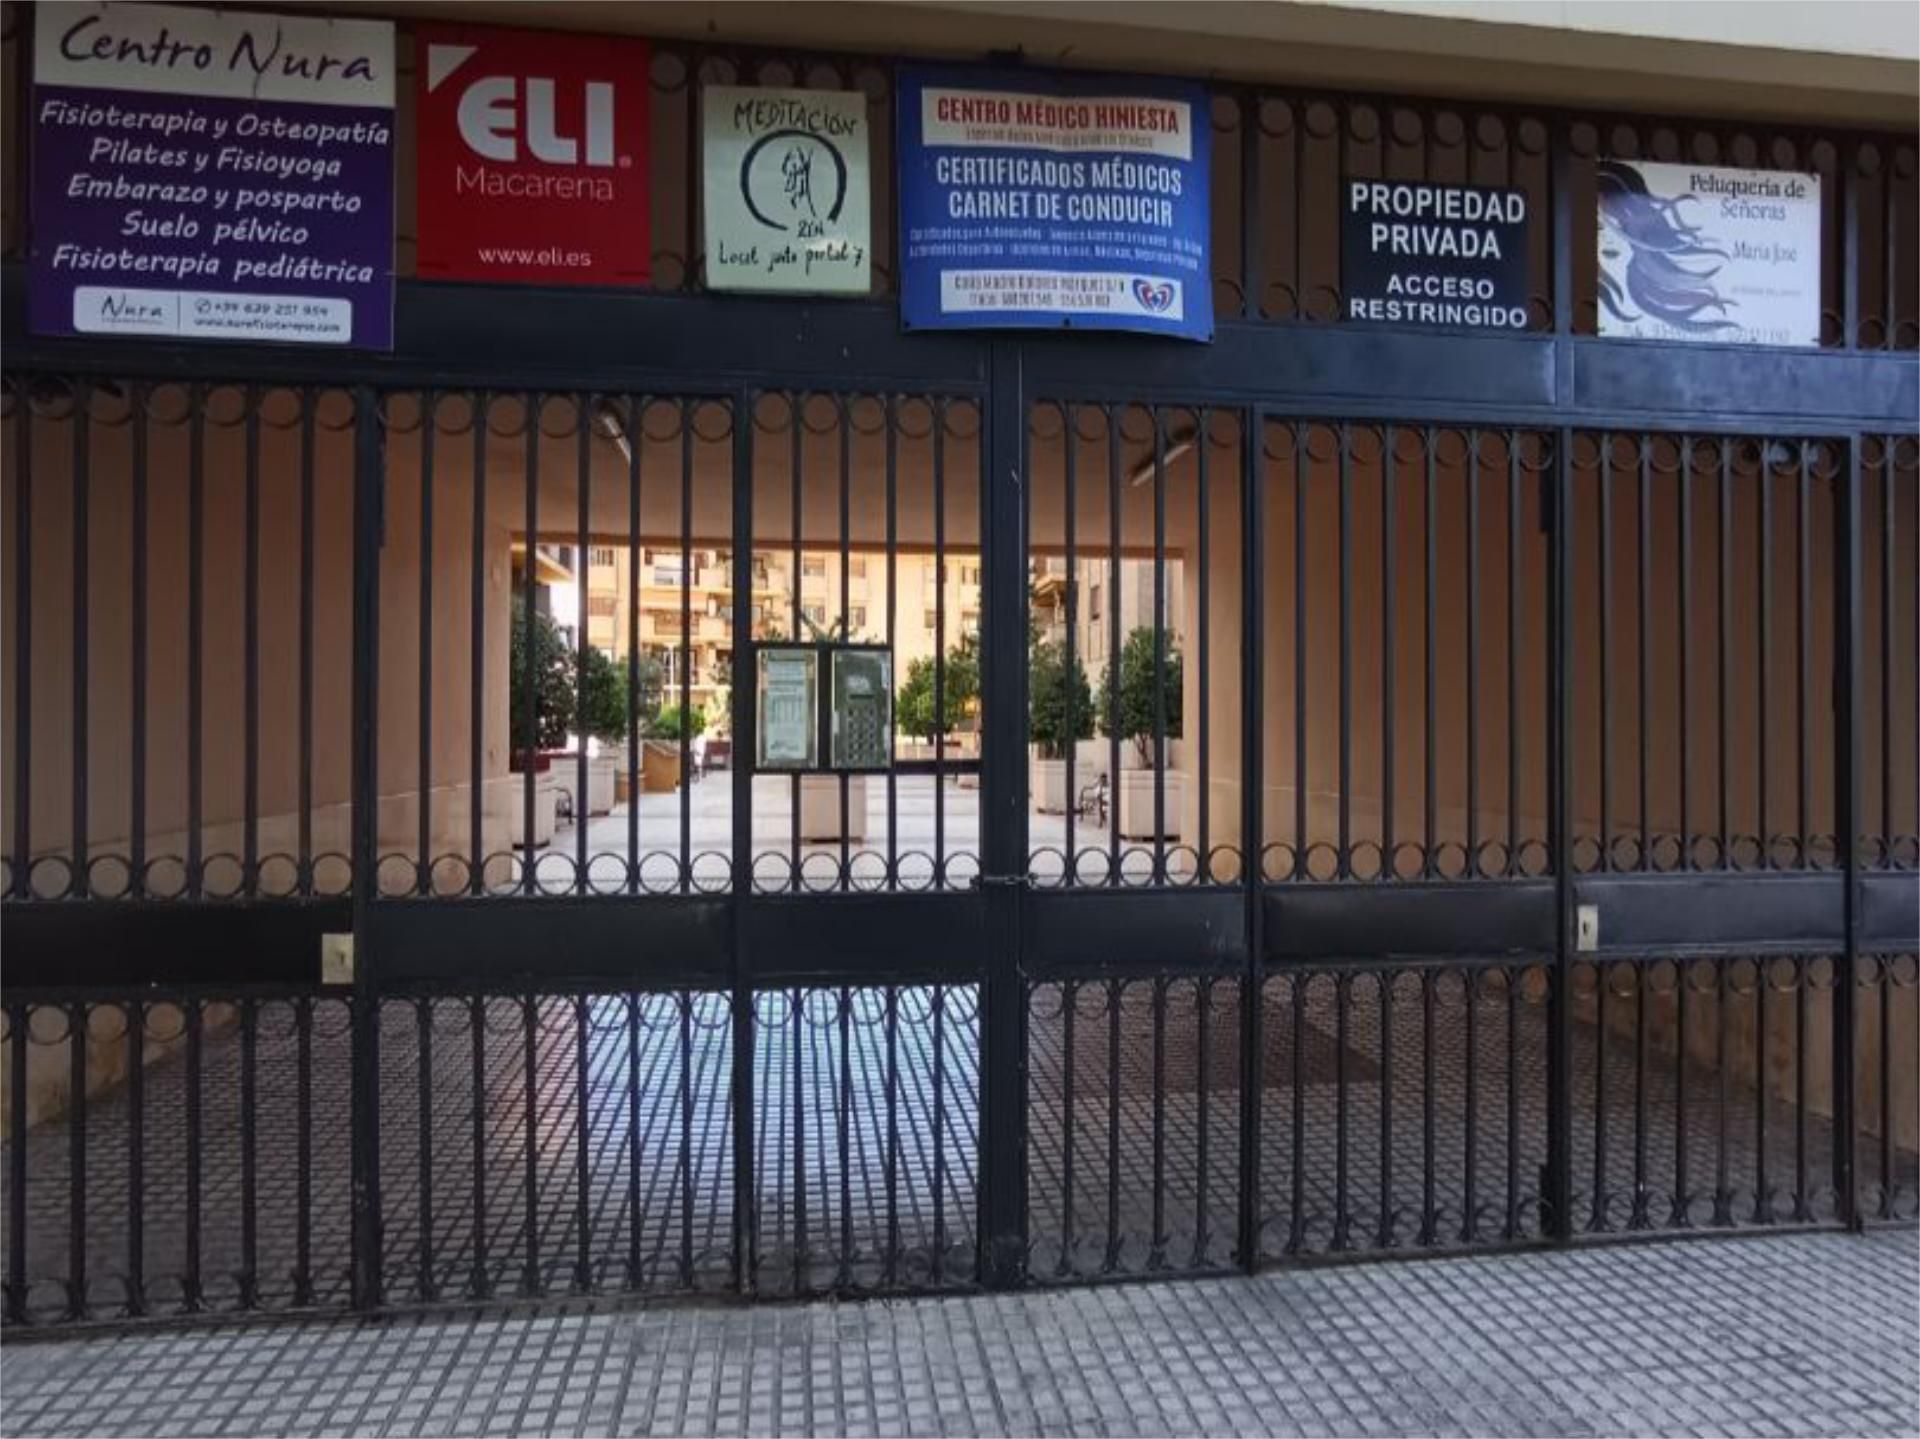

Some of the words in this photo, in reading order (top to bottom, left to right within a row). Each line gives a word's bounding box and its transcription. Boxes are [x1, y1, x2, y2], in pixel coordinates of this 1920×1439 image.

[60, 15, 212, 70] Centro
[229, 23, 375, 81] Nura
[40, 100, 207, 136] Fisioterapia
[214, 117, 229, 138] y
[236, 113, 390, 146] Osteopatía
[457, 76, 615, 166] ELI
[937, 97, 1010, 125] CENTRO
[1015, 98, 1090, 130] MÉDICO
[1096, 105, 1179, 134] HINIESTA
[89, 138, 188, 167] Pilates
[195, 152, 209, 172] y
[217, 146, 342, 181] Fisioyoga
[936, 156, 1085, 189] CERTIFICADOS
[1091, 156, 1182, 195] MÉDICOS
[67, 174, 208, 204] Embarazo
[214, 190, 229, 211] y
[235, 189, 362, 213] posparto
[456, 166, 614, 201] Macarena
[1784, 181, 1806, 198] de
[949, 191, 1030, 219] CARNET
[1036, 194, 1062, 220] DE
[1068, 196, 1173, 228] CONDUCIR
[1352, 182, 1526, 224] PROPIEDAD
[1720, 199, 1786, 221] Señoras
[121, 211, 199, 239] Suelo
[213, 216, 310, 245] pélvico
[1371, 222, 1502, 259] PRIVADA
[52, 246, 220, 276] Fisioterapia
[234, 254, 375, 283] pediátrica
[478, 247, 592, 268] www.eli.es
[1386, 274, 1495, 299] ACCESO
[101, 294, 163, 319] Nura
[1350, 298, 1527, 328] RESTRINGIDO
